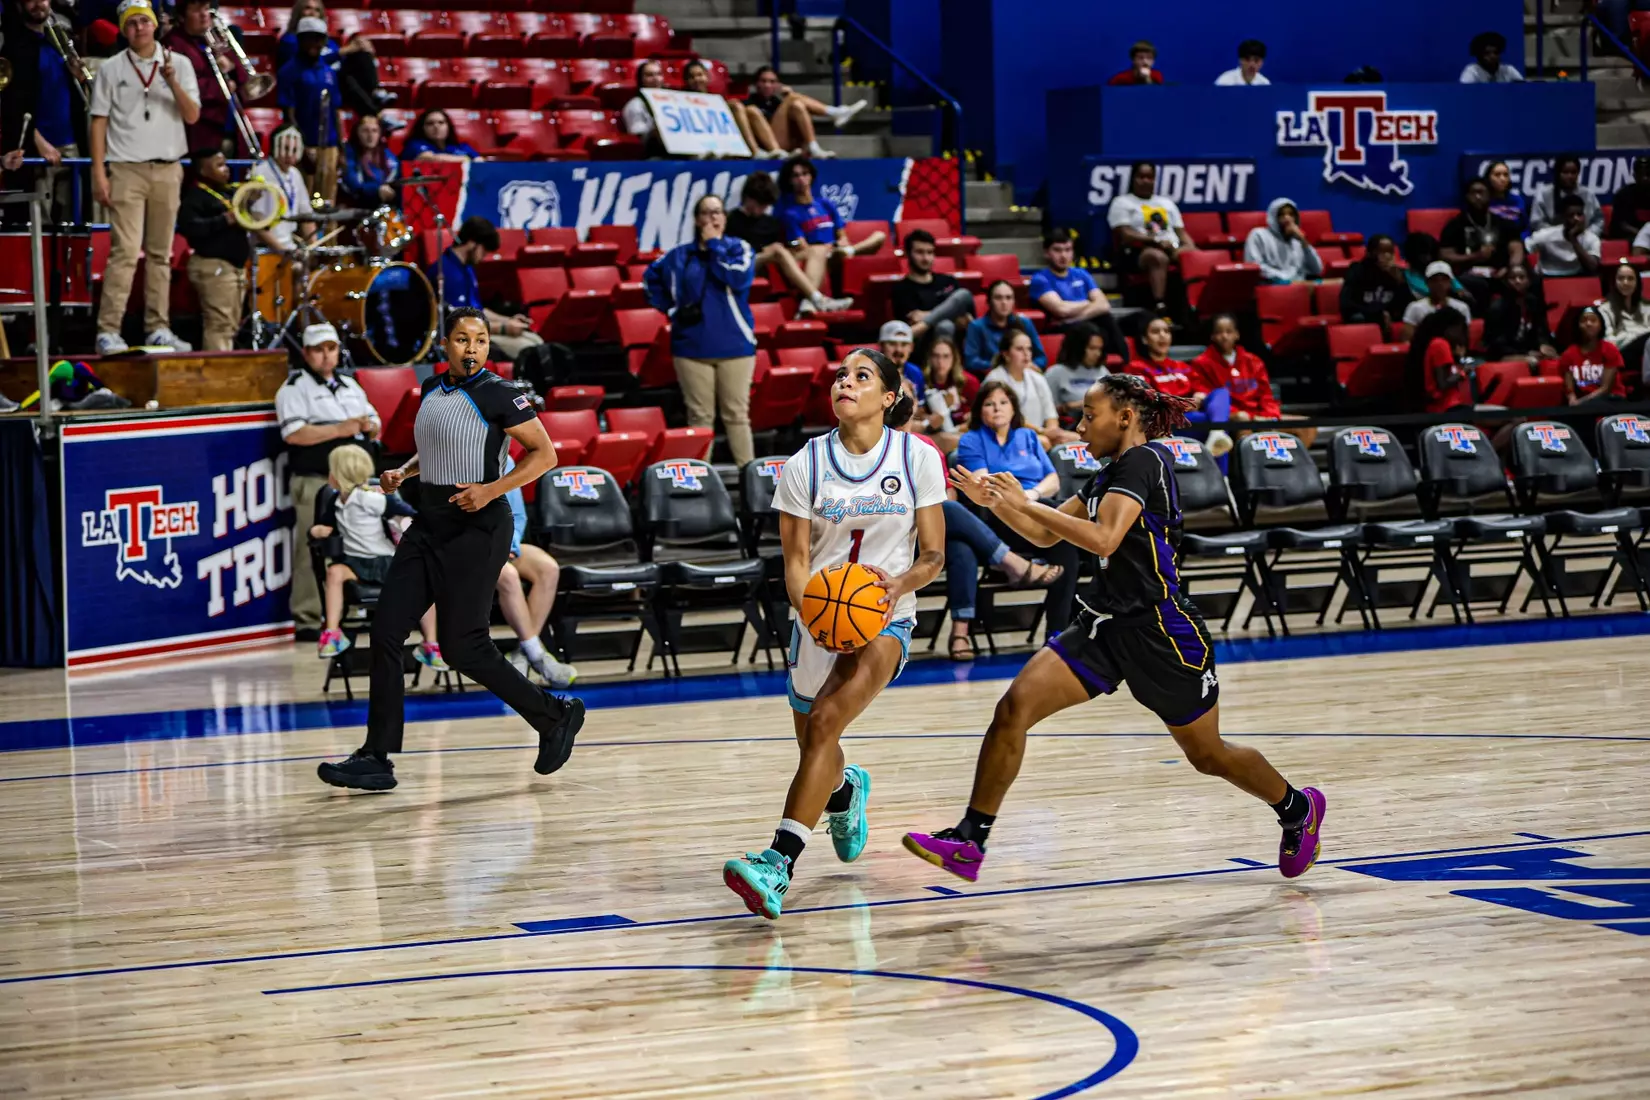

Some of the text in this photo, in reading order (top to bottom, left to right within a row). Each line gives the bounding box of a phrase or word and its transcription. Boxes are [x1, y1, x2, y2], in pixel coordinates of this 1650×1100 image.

[662, 105, 740, 134] SILVIA
[1277, 91, 1437, 165] LA TECH
[575, 171, 779, 251] KENN
[1088, 164, 1255, 205] STDENT
[82, 485, 199, 562] LA TECH
[813, 494, 908, 524] Lady Techsters
[197, 527, 296, 617] TRO
[848, 529, 865, 563] 1
